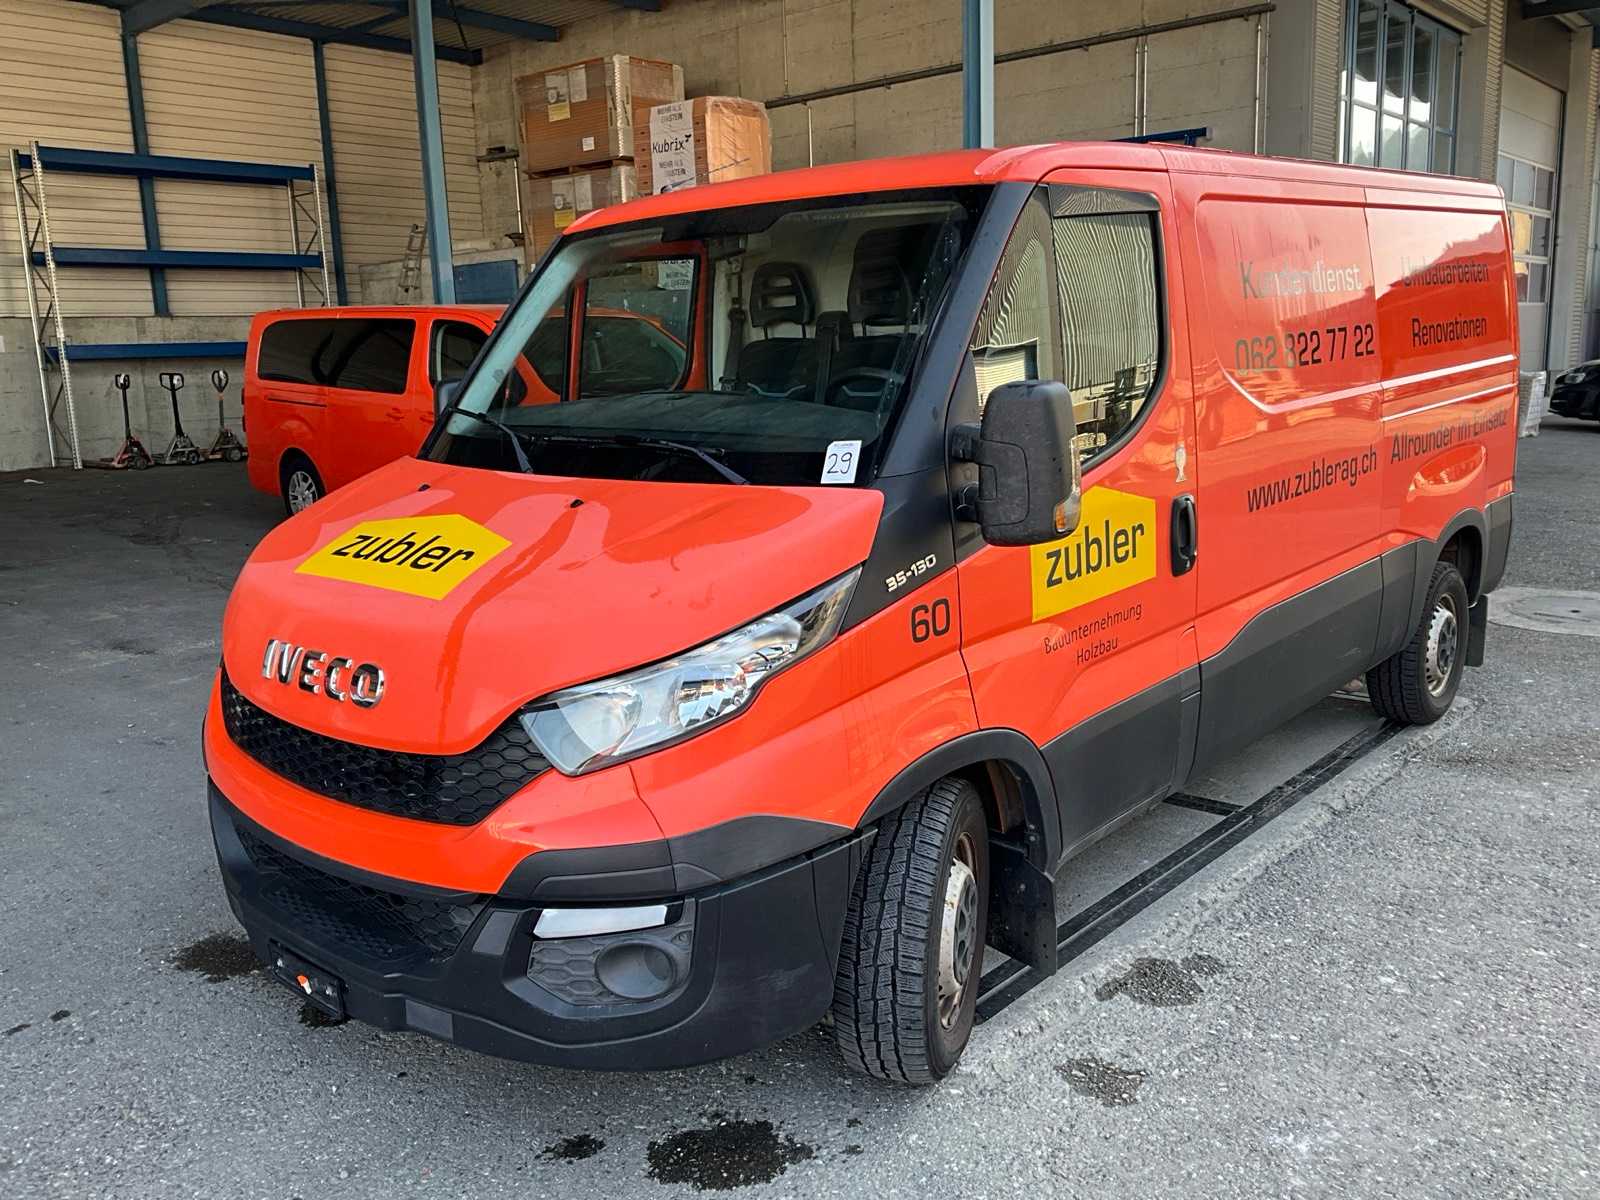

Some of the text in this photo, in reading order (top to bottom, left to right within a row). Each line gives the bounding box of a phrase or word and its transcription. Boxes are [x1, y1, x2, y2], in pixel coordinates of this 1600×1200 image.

[652, 137, 685, 153] Kubrix
[1239, 257, 1362, 299] Kundendienst
[1235, 323, 1376, 376] 062 822 77 22
[1411, 313, 1487, 347] Renovationen
[827, 452, 852, 474] 29
[1391, 422, 1456, 464] Allrounder
[1247, 445, 1377, 512] www.zublerag.ch
[331, 532, 475, 572] zubler
[885, 554, 937, 592] 35-130
[1046, 520, 1145, 588] zubler
[911, 598, 951, 643] 60
[1044, 602, 1143, 655] Bauunternehmung
[1076, 637, 1118, 665] Holzbau
[261, 639, 385, 709] IVECO
